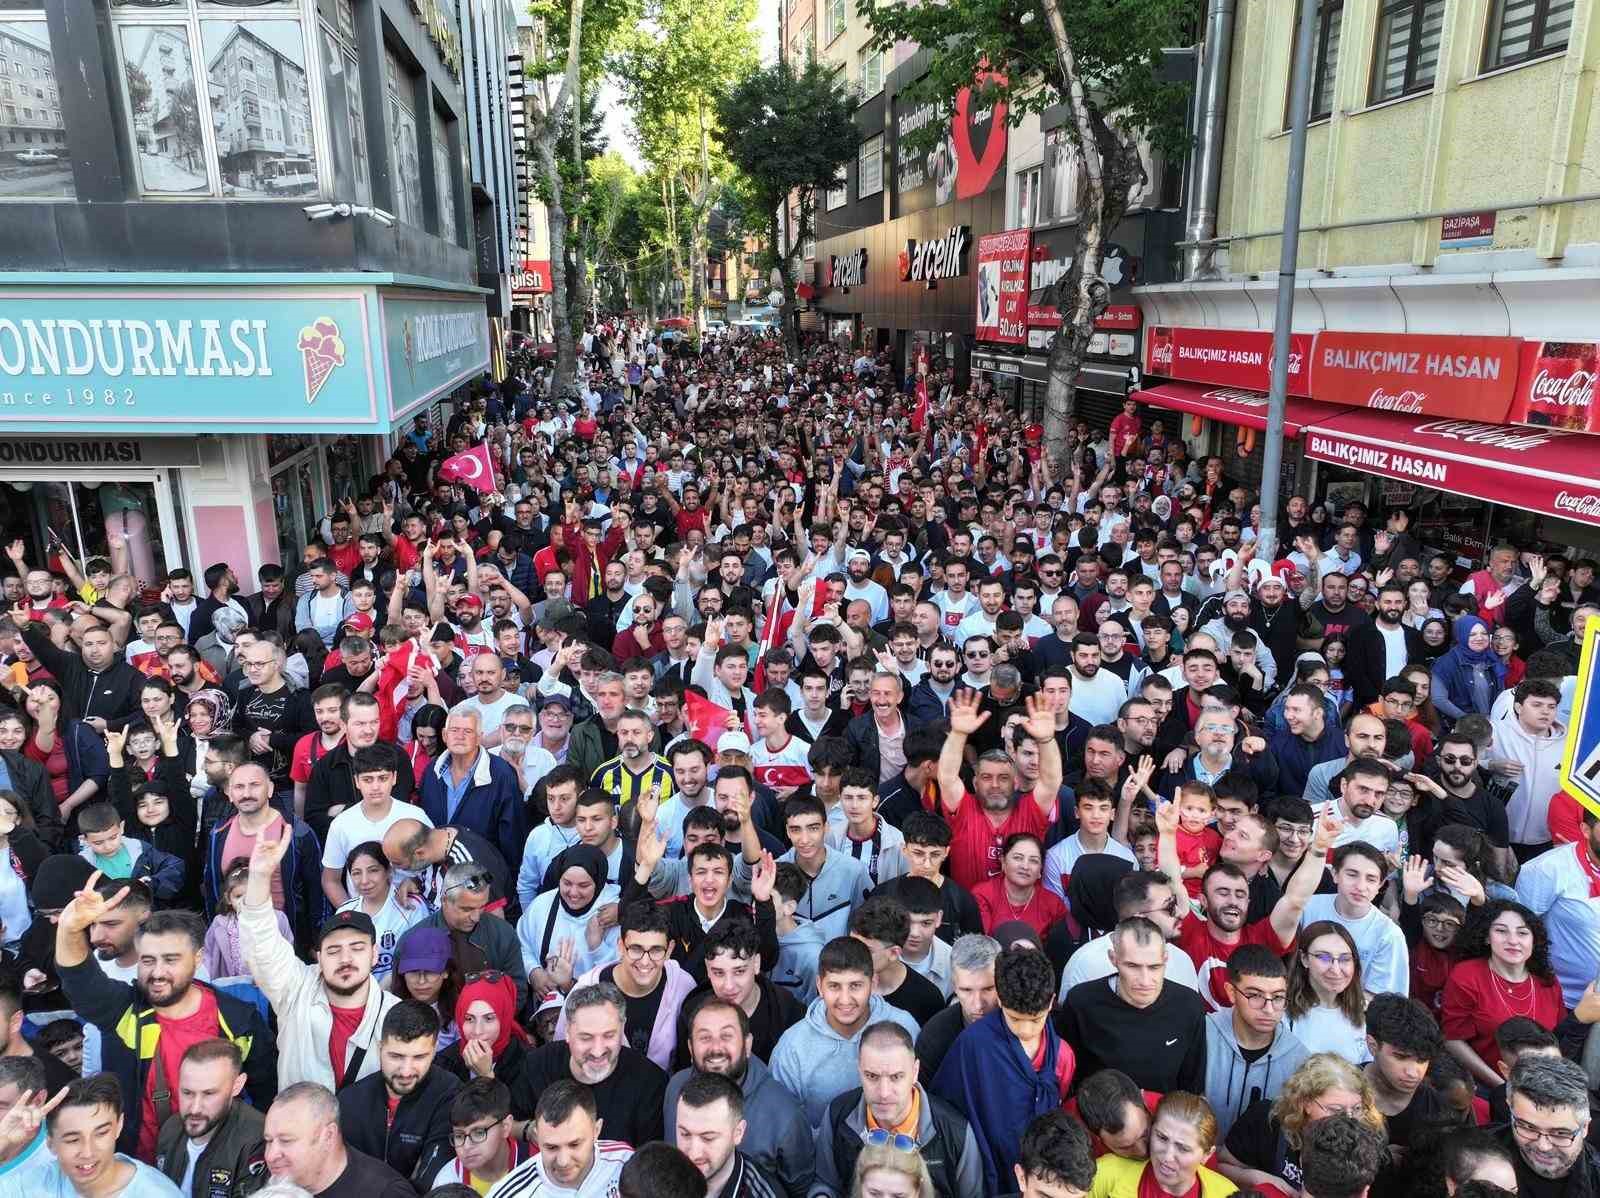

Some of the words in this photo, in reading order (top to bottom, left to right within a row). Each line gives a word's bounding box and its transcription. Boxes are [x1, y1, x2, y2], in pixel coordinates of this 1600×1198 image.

[833, 247, 864, 296] arçelik
[911, 225, 964, 290] arçelik
[1179, 346, 1227, 364] BALIKÇIMIZ
[1229, 350, 1263, 365] HASAN
[1323, 348, 1420, 375] BALIKÇIMIZ
[1425, 352, 1501, 380] HASAN
[66, 388, 137, 406] 1982
[1530, 368, 1597, 407] Coca-Cola
[1311, 437, 1388, 465] BALIKÇIMIZ
[1391, 454, 1448, 483] HASAN
